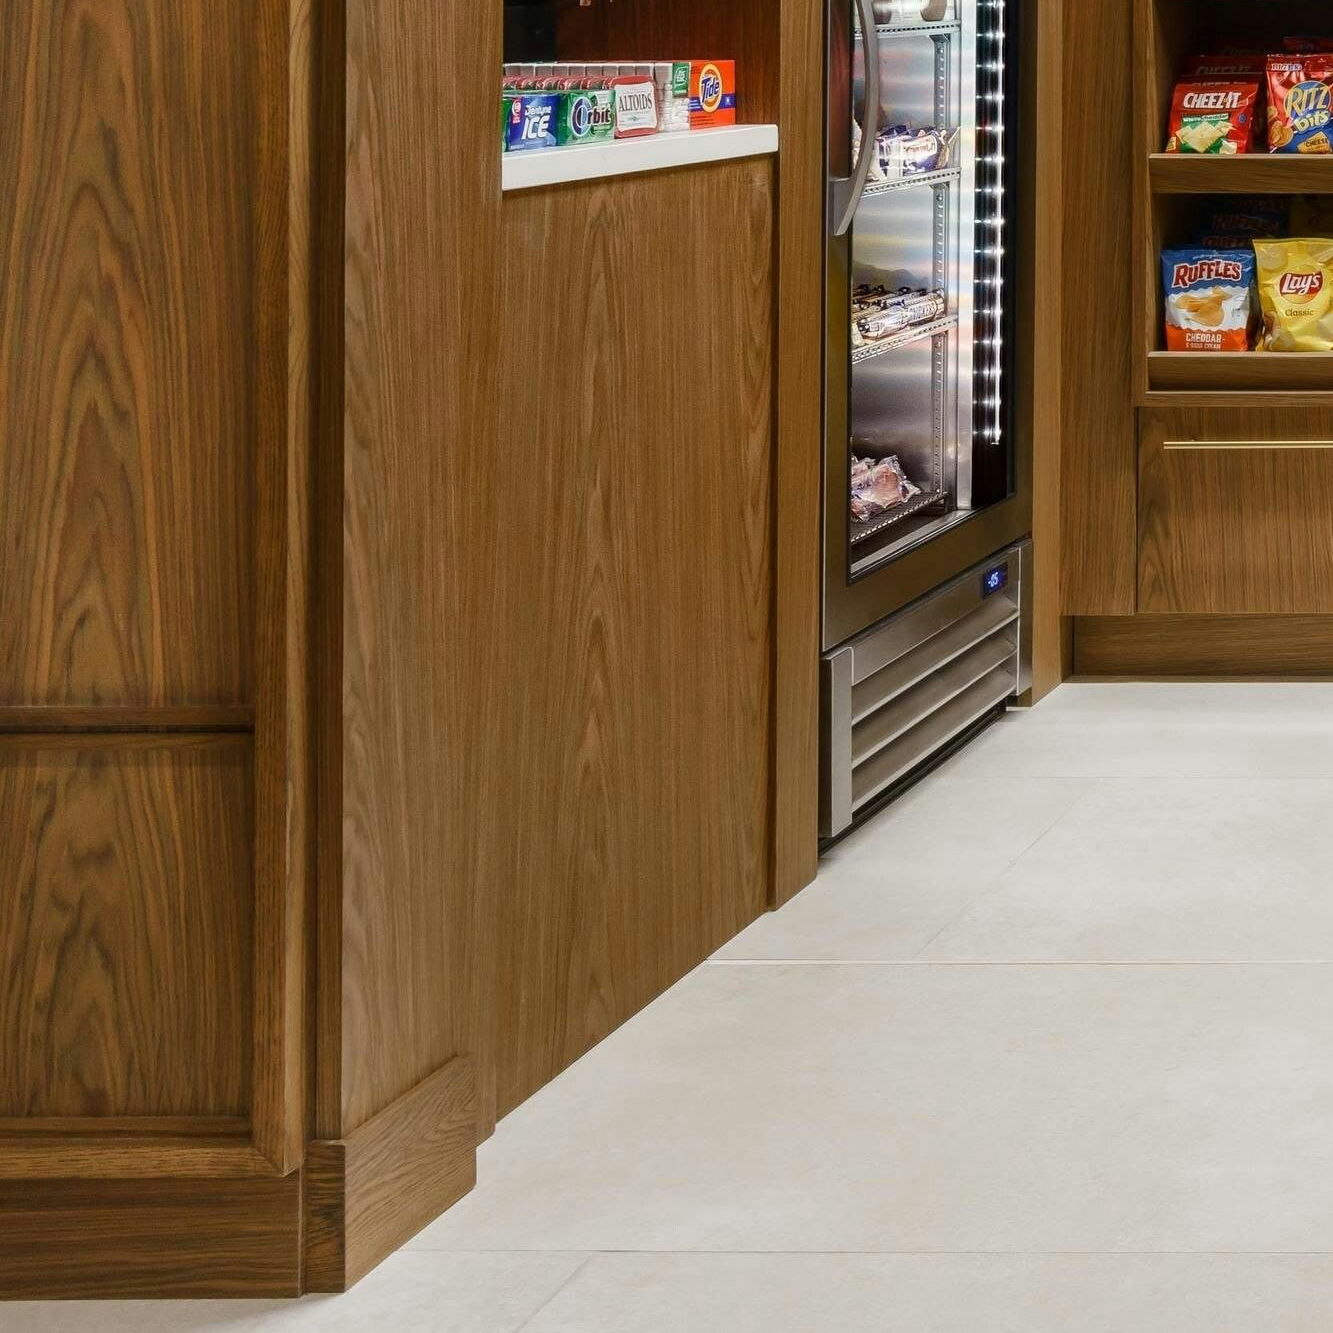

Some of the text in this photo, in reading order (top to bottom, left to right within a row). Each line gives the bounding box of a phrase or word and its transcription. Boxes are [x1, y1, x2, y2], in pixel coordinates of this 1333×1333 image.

[701, 72, 720, 102] Tide
[525, 104, 552, 116] Dentyne
[618, 93, 652, 113] ALTOIDS
[1285, 85, 1331, 116] RITZ
[571, 96, 611, 137] Orbit
[522, 117, 549, 140] ICE
[1172, 259, 1243, 288] RUFFLES
[1280, 272, 1321, 296] Lay's
[1285, 308, 1315, 317] Classic
[1186, 333, 1222, 343] CHEDDAR
